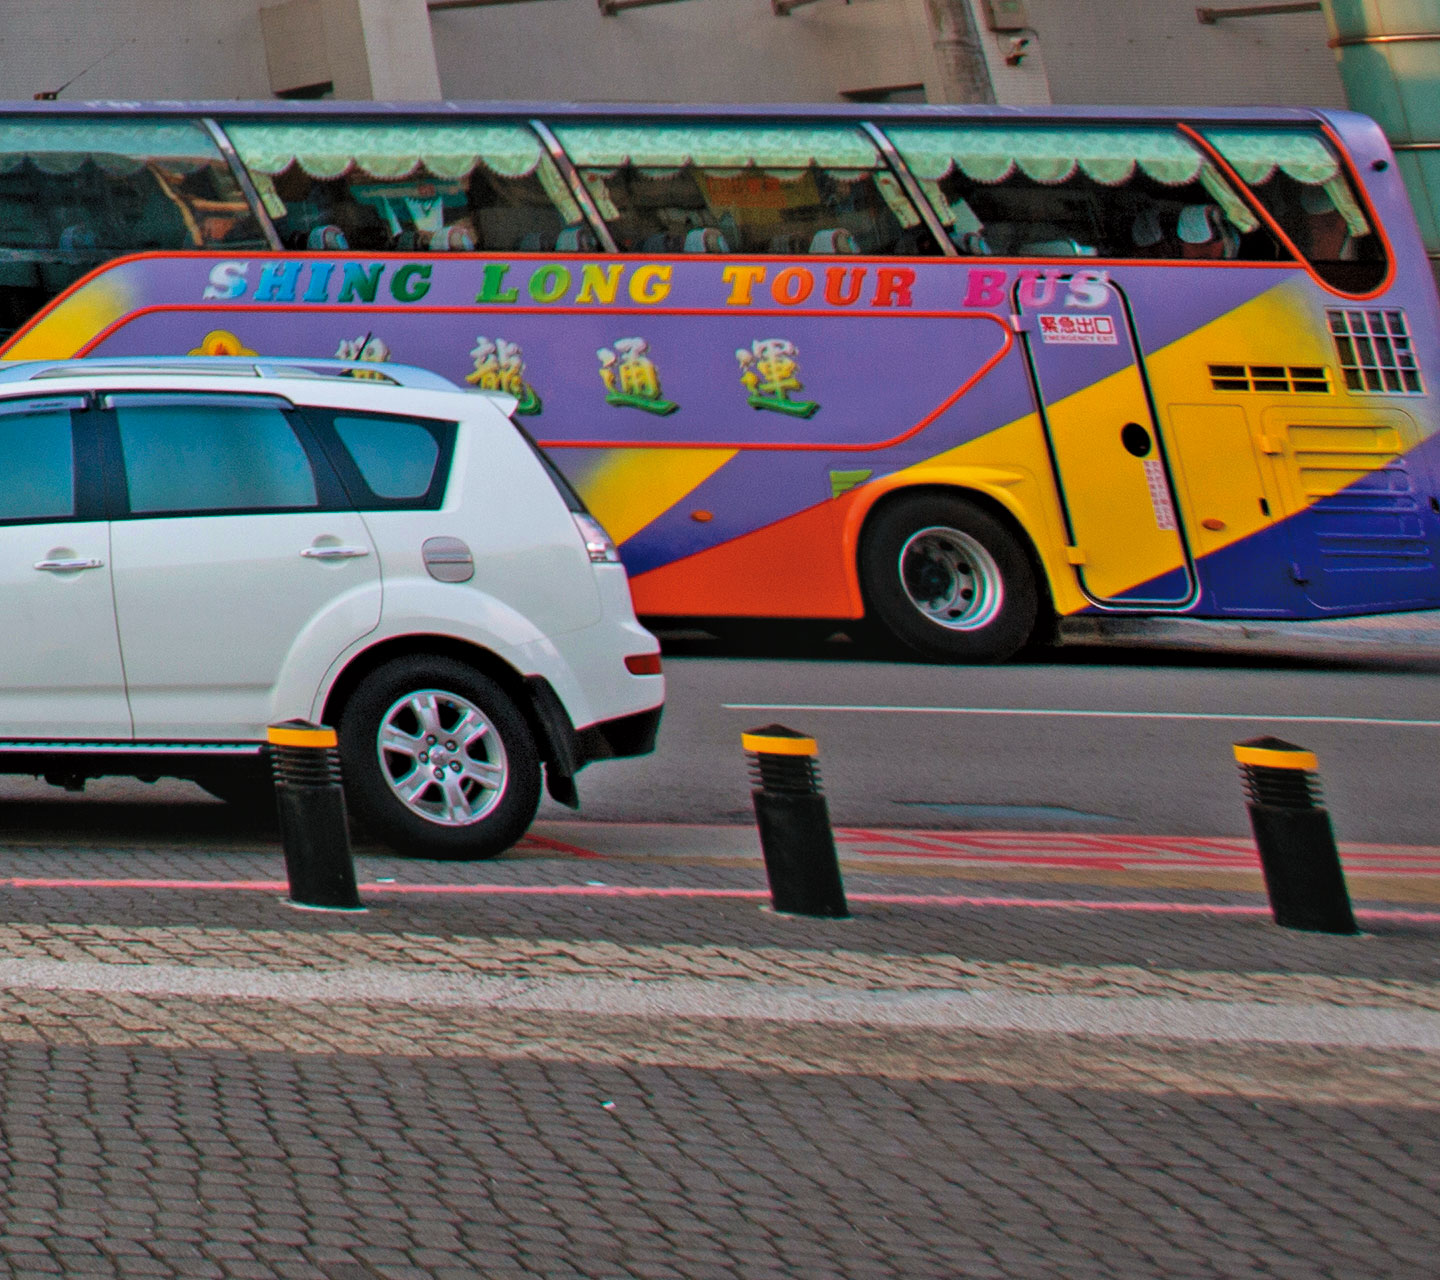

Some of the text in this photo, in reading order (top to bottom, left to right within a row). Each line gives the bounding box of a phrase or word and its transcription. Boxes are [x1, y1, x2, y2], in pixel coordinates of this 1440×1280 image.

[203, 261, 1111, 309] SHING LONG TOUR BUS
[1040, 316, 1112, 335] 緊急出口
